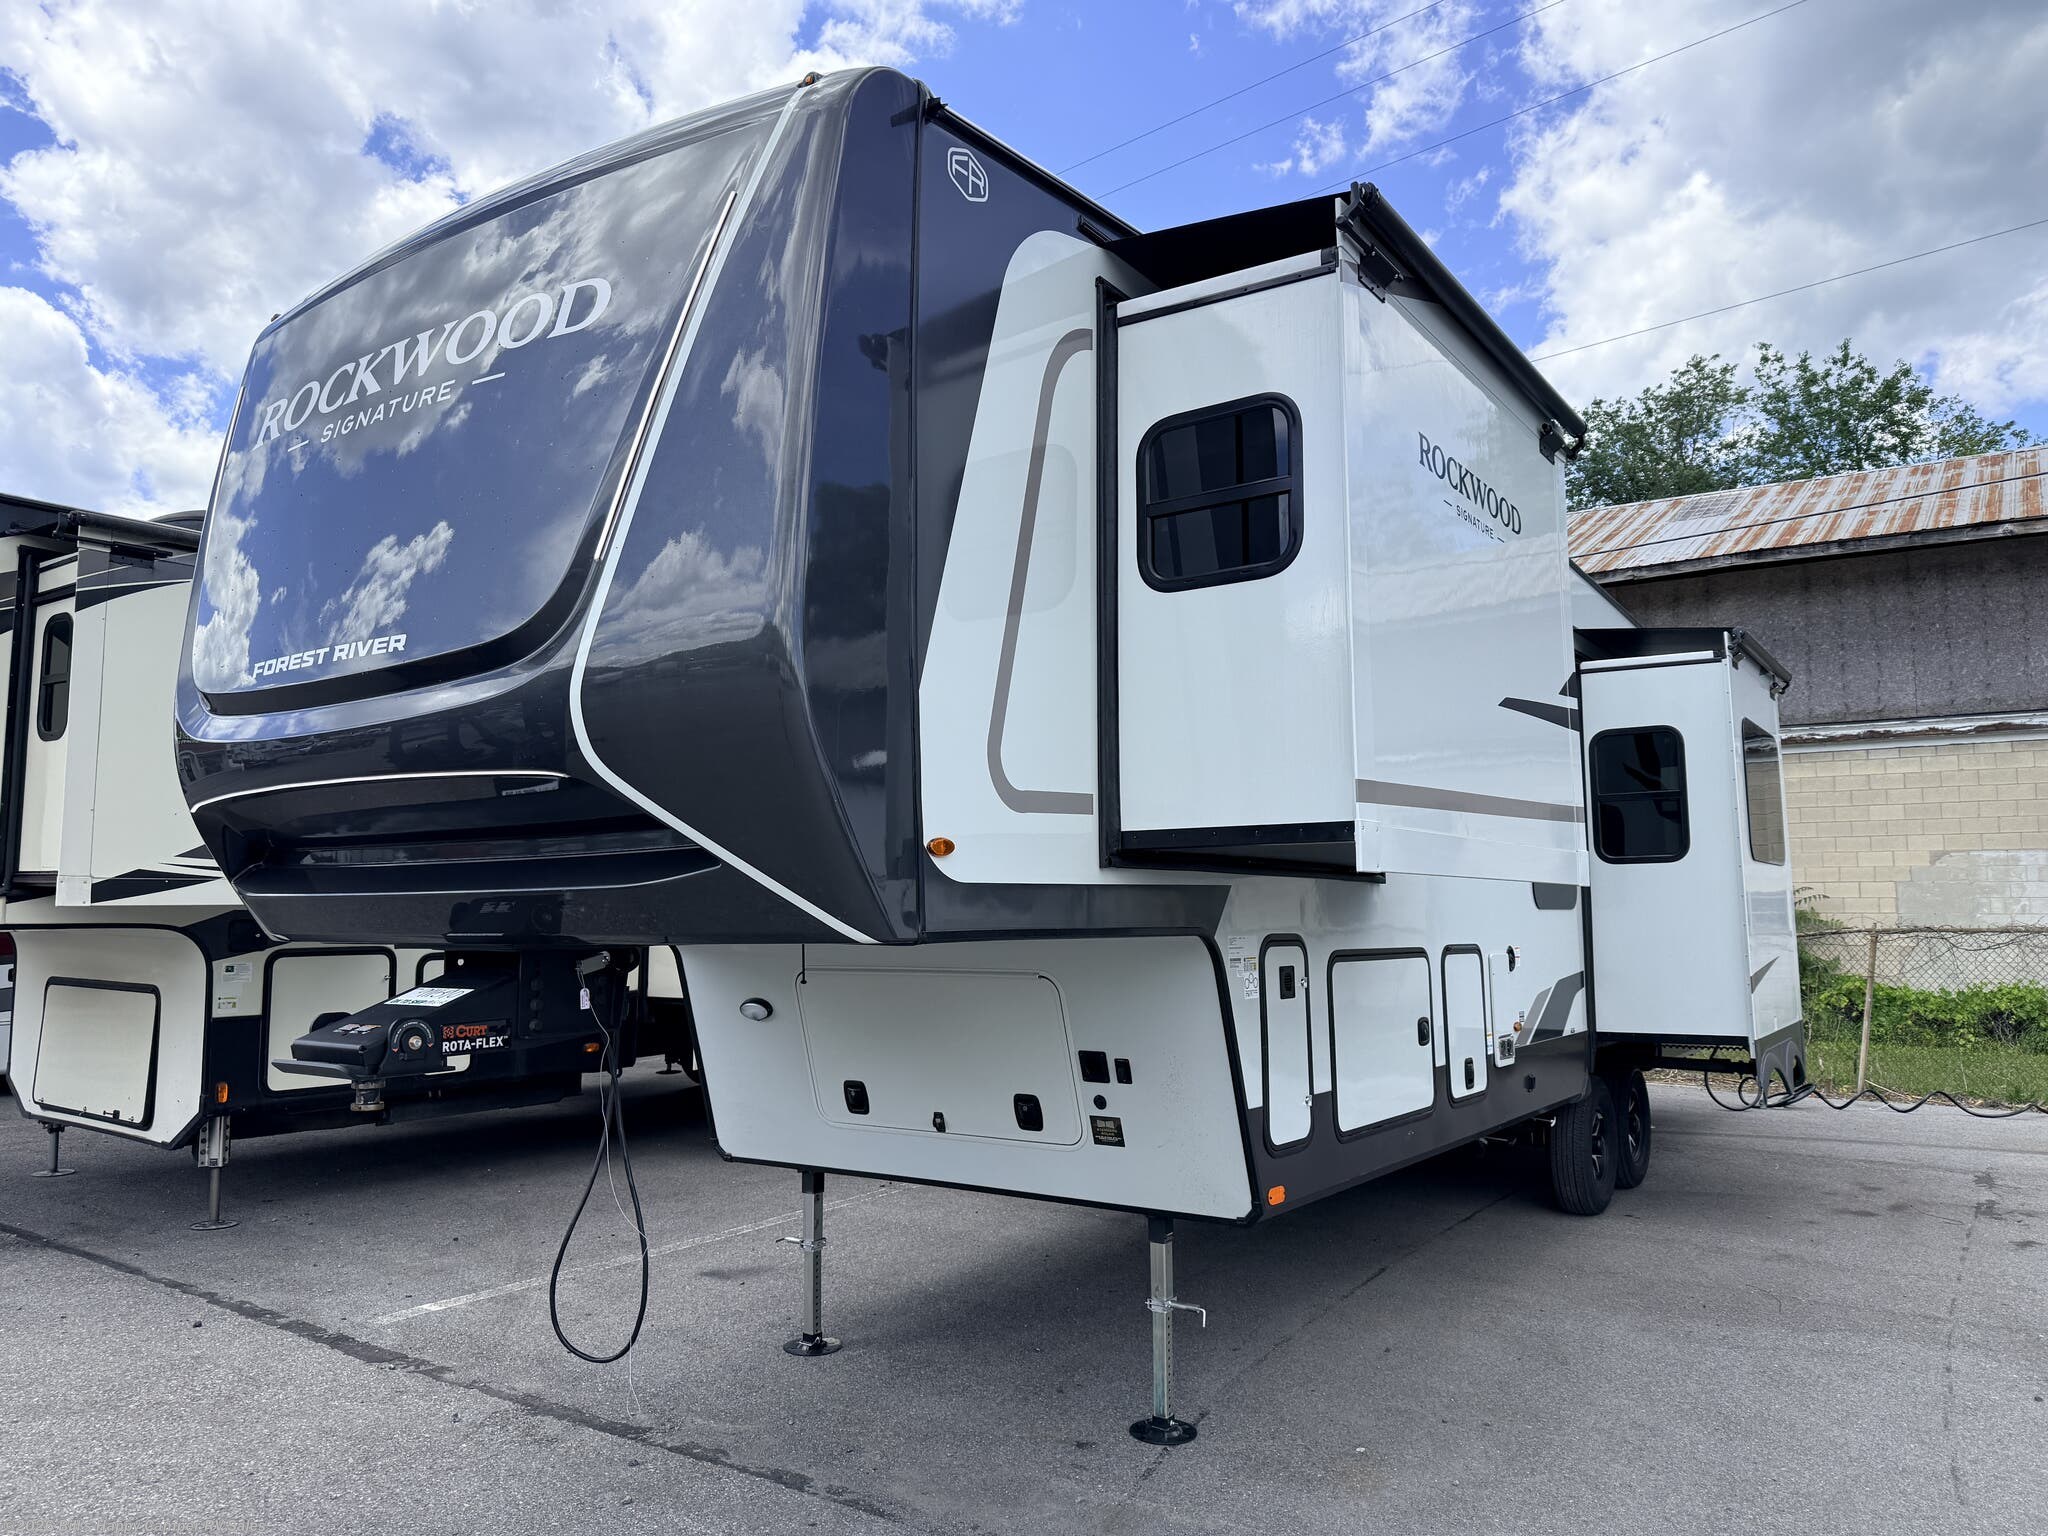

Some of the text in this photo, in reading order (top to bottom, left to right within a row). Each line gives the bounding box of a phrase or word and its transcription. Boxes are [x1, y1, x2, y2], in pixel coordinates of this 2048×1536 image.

[253, 277, 613, 451] ROCKWOOD
[320, 380, 455, 443] SIGNATURE
[1418, 431, 1522, 535] ROCKWOOD
[1456, 505, 1494, 539] SIGNATURE
[253, 634, 407, 679] FOREST RIVER
[456, 1025, 488, 1038] CURT
